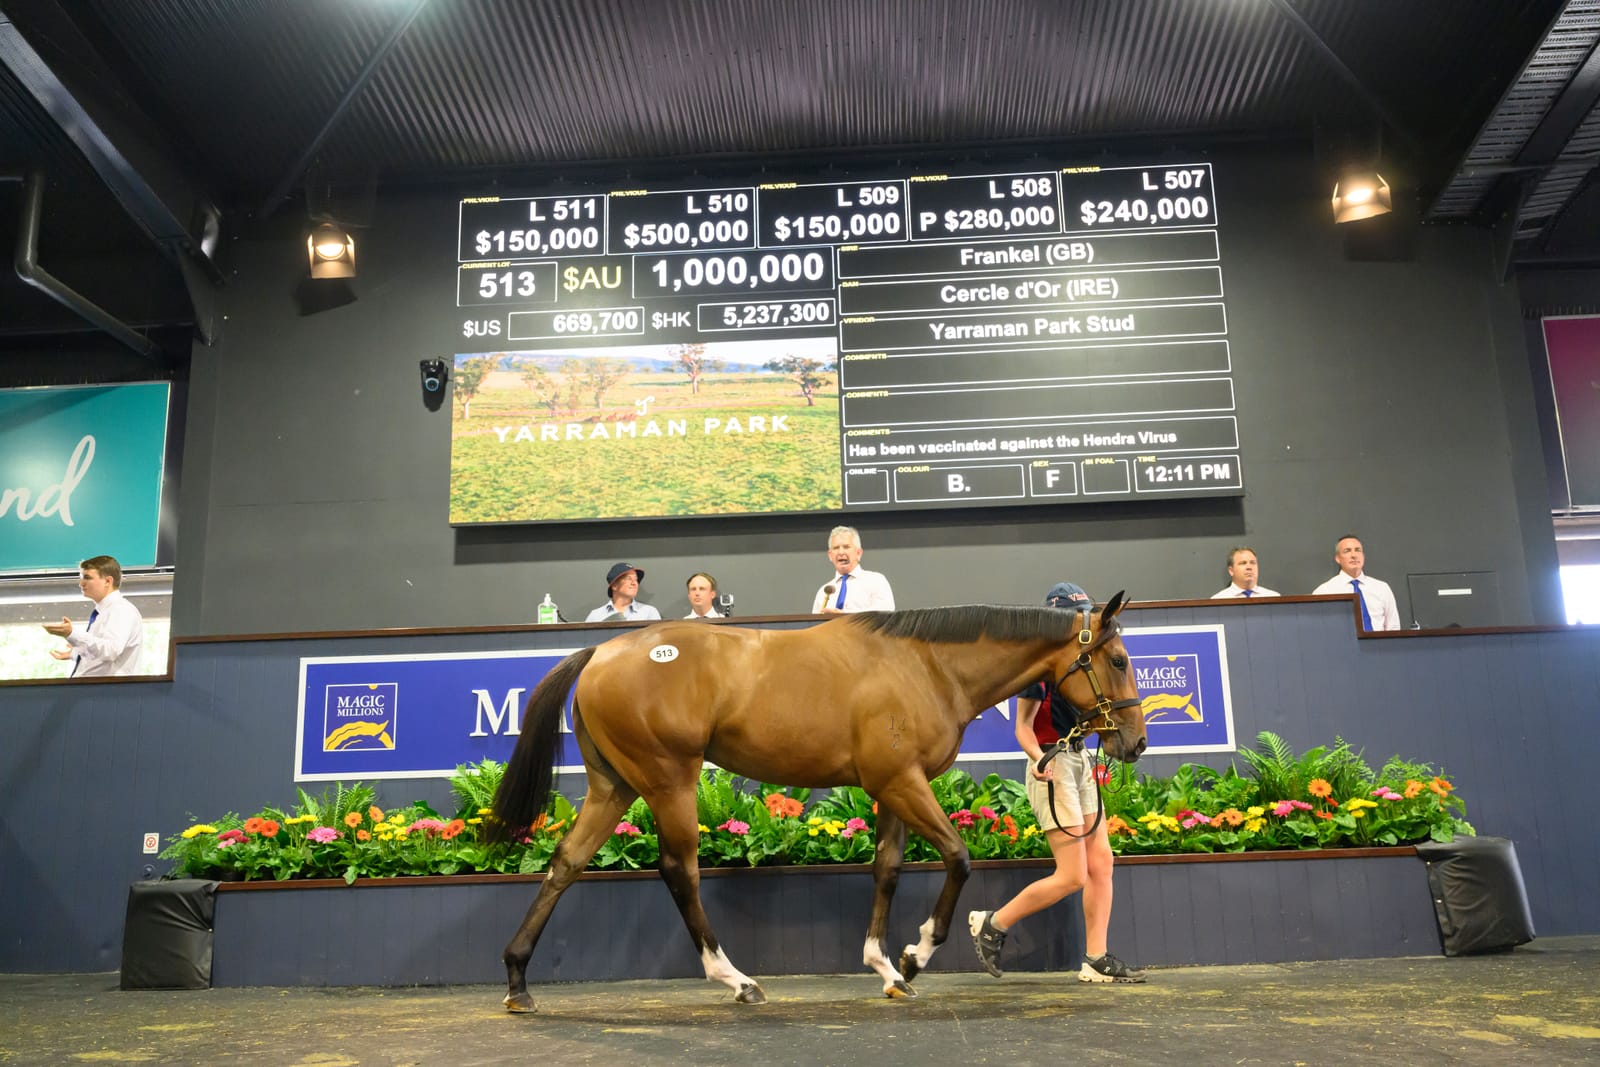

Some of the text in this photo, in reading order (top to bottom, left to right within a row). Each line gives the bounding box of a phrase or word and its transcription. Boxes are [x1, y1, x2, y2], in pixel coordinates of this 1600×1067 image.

[989, 178, 1052, 199] L 508
[1142, 170, 1205, 190] L 507
[686, 193, 748, 215] L 510
[837, 186, 899, 208] L 509
[530, 199, 596, 222] L 511
[919, 206, 1055, 233] P $280,000
[1080, 196, 1209, 227] $240,000
[624, 219, 748, 248] $500,000
[774, 213, 900, 244] $150,000
[475, 227, 599, 255] $150,000
[960, 242, 1095, 266] Frankel (GB)
[563, 265, 622, 291] $AU
[652, 253, 824, 291] 1,000,000
[478, 272, 536, 298] 513
[940, 277, 1119, 304] Cercle d'Or (IRE)
[552, 311, 638, 335] 669,700
[651, 311, 691, 330] $HK
[723, 302, 830, 327] 5,237,300
[463, 319, 501, 338] $US
[929, 314, 1135, 340] Yarraman Park Stud
[493, 414, 789, 443] YARRAMAN PARK
[849, 431, 1177, 457] Has been vaccinated against the Hendra Virus
[947, 473, 972, 493] B.
[1046, 470, 1060, 488] F
[1145, 463, 1230, 482] 12:11 PM
[656, 649, 673, 658] 513
[1136, 666, 1186, 681] MAGIC
[1137, 679, 1187, 689] MILLIONS
[337, 694, 385, 708] MAGIC
[337, 706, 384, 717] MILLIONS
